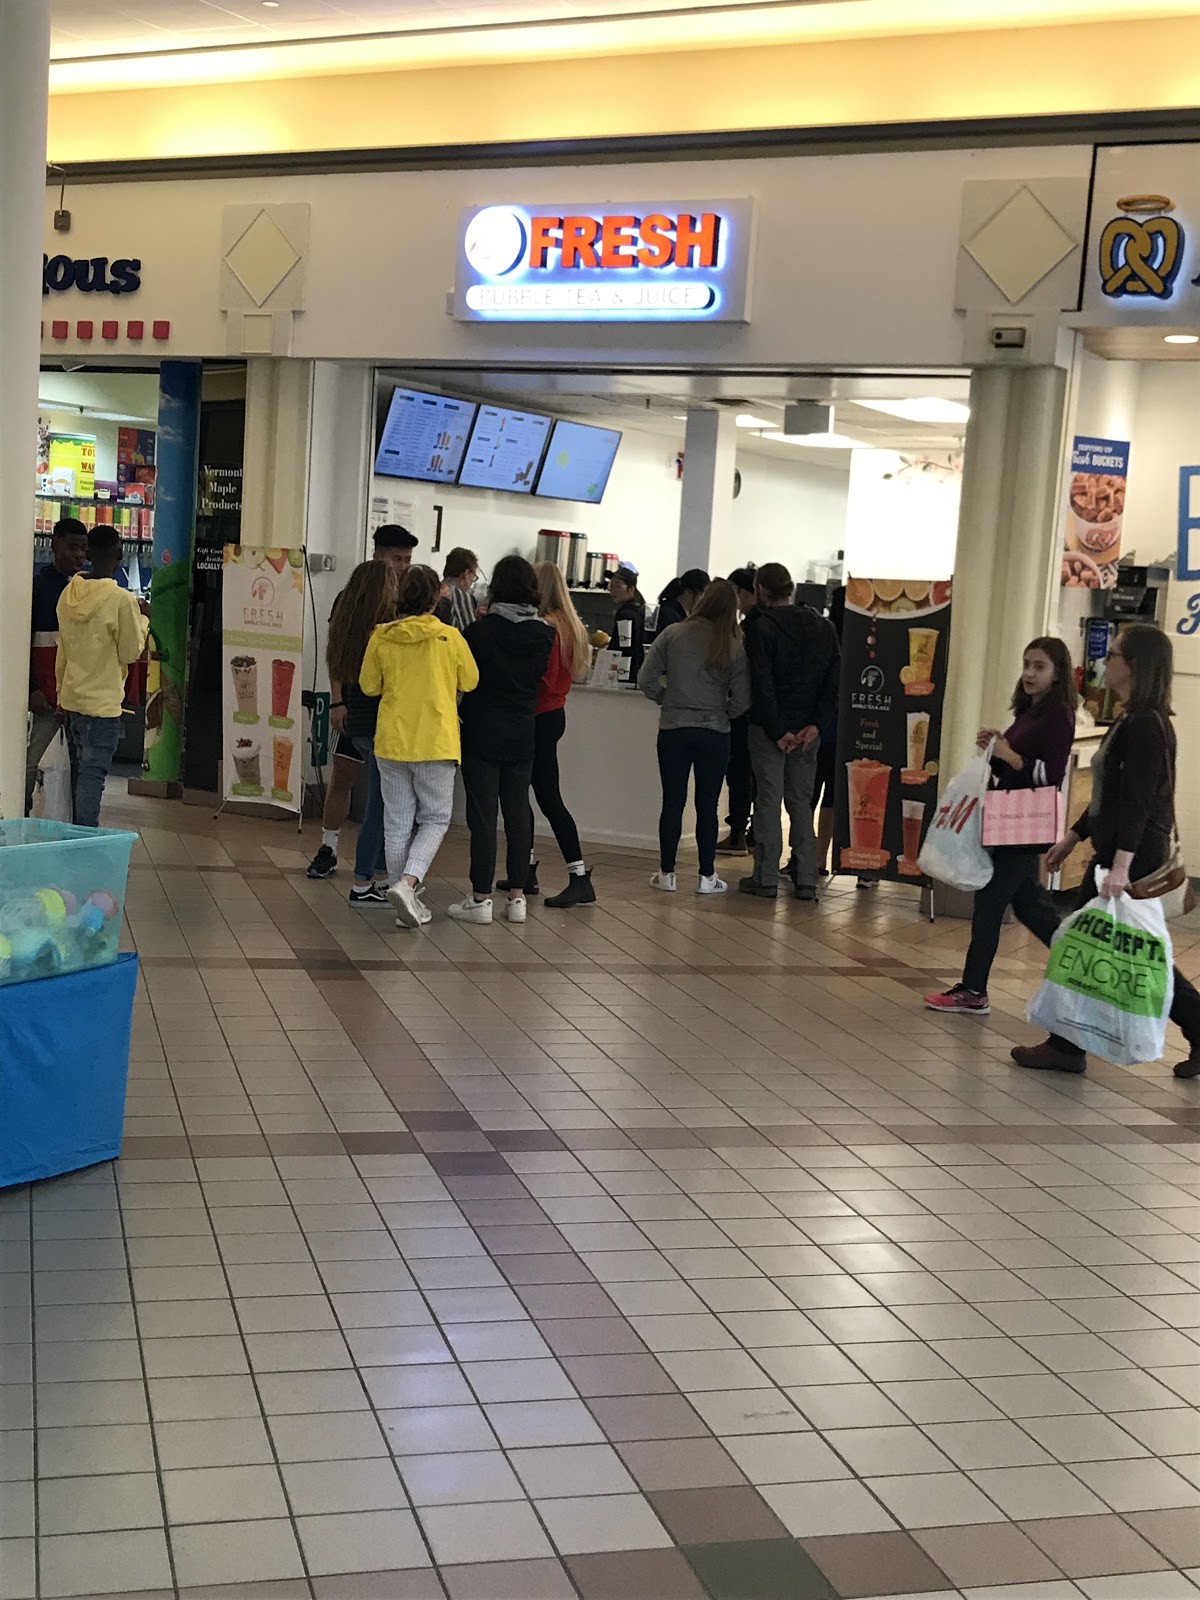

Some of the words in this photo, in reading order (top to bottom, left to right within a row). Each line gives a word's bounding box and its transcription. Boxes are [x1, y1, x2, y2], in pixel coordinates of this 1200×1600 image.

[529, 213, 721, 269] FRESH
[43, 253, 142, 294] ous
[479, 288, 554, 305] BUBBLE
[567, 289, 602, 305] TEA
[611, 288, 625, 305] &
[635, 287, 696, 305] JUICE
[1091, 454, 1124, 469] BUCKETS
[209, 481, 237, 496] Maple
[196, 561, 221, 570] LOCALLY
[243, 607, 284, 622] FRESH
[851, 692, 892, 705] FRESH
[862, 729, 877, 739] and
[855, 740, 883, 751] Special
